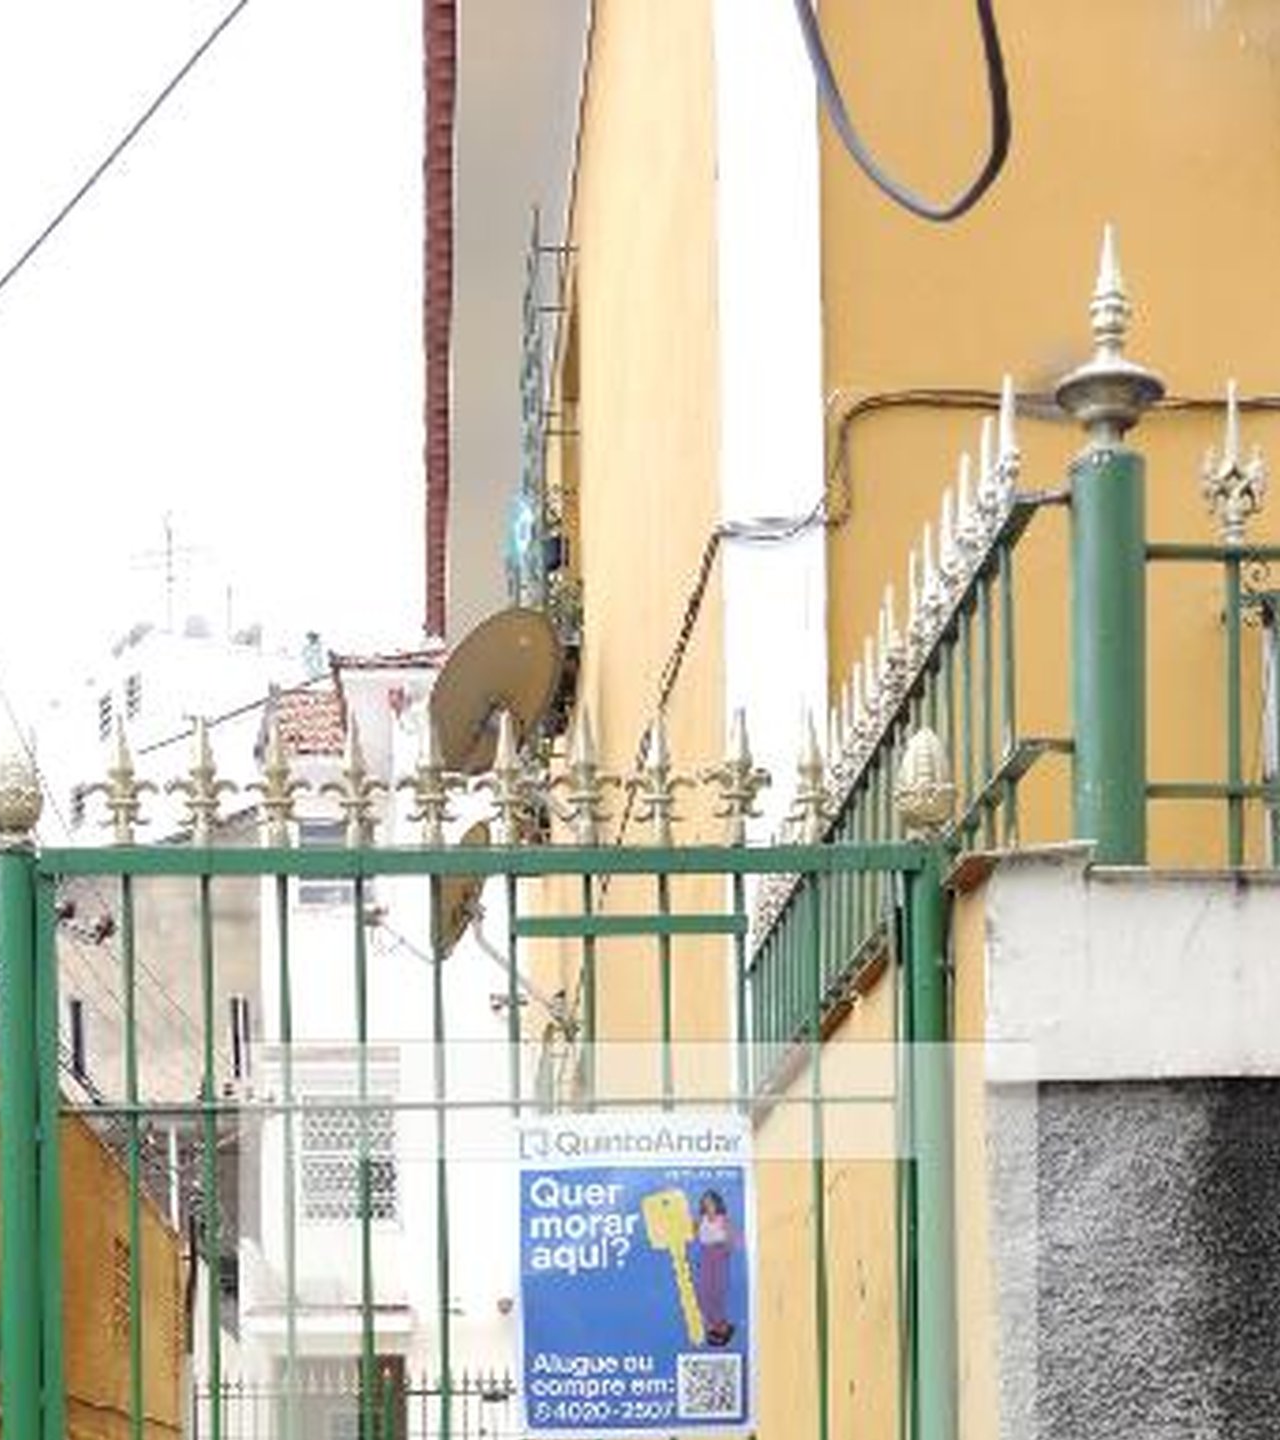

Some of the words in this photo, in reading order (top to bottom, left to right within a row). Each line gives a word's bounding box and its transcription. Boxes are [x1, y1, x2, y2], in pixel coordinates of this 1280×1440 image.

[556, 1128, 743, 1157] QuintoAndar
[530, 1176, 624, 1207] Quer
[530, 1212, 639, 1239] morar
[530, 1237, 631, 1275] aqui?
[531, 1353, 619, 1377] Alugue
[624, 1355, 654, 1372] ou
[531, 1377, 625, 1401] compre
[631, 1377, 675, 1395] em:
